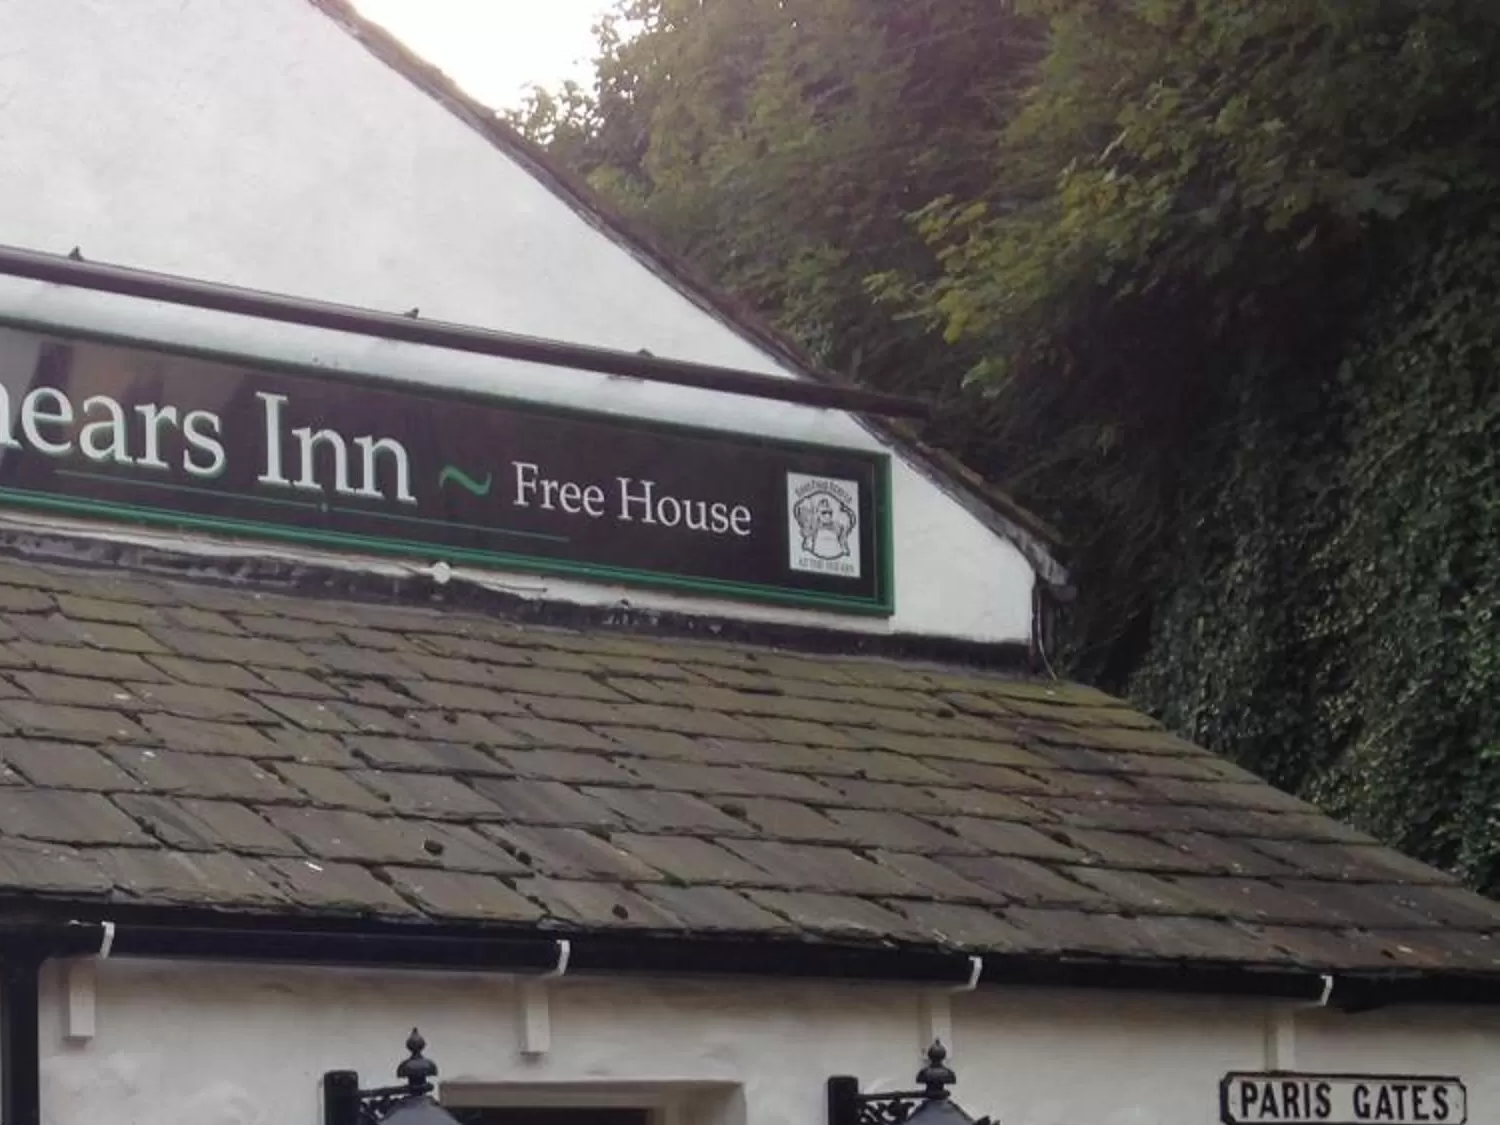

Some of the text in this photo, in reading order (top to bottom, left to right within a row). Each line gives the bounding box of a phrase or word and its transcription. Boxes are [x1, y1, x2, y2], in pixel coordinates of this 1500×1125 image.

[256, 391, 417, 501] Inn
[512, 460, 605, 518] Free
[616, 476, 752, 536] House
[1240, 1080, 1450, 1121] PARIS GATES
